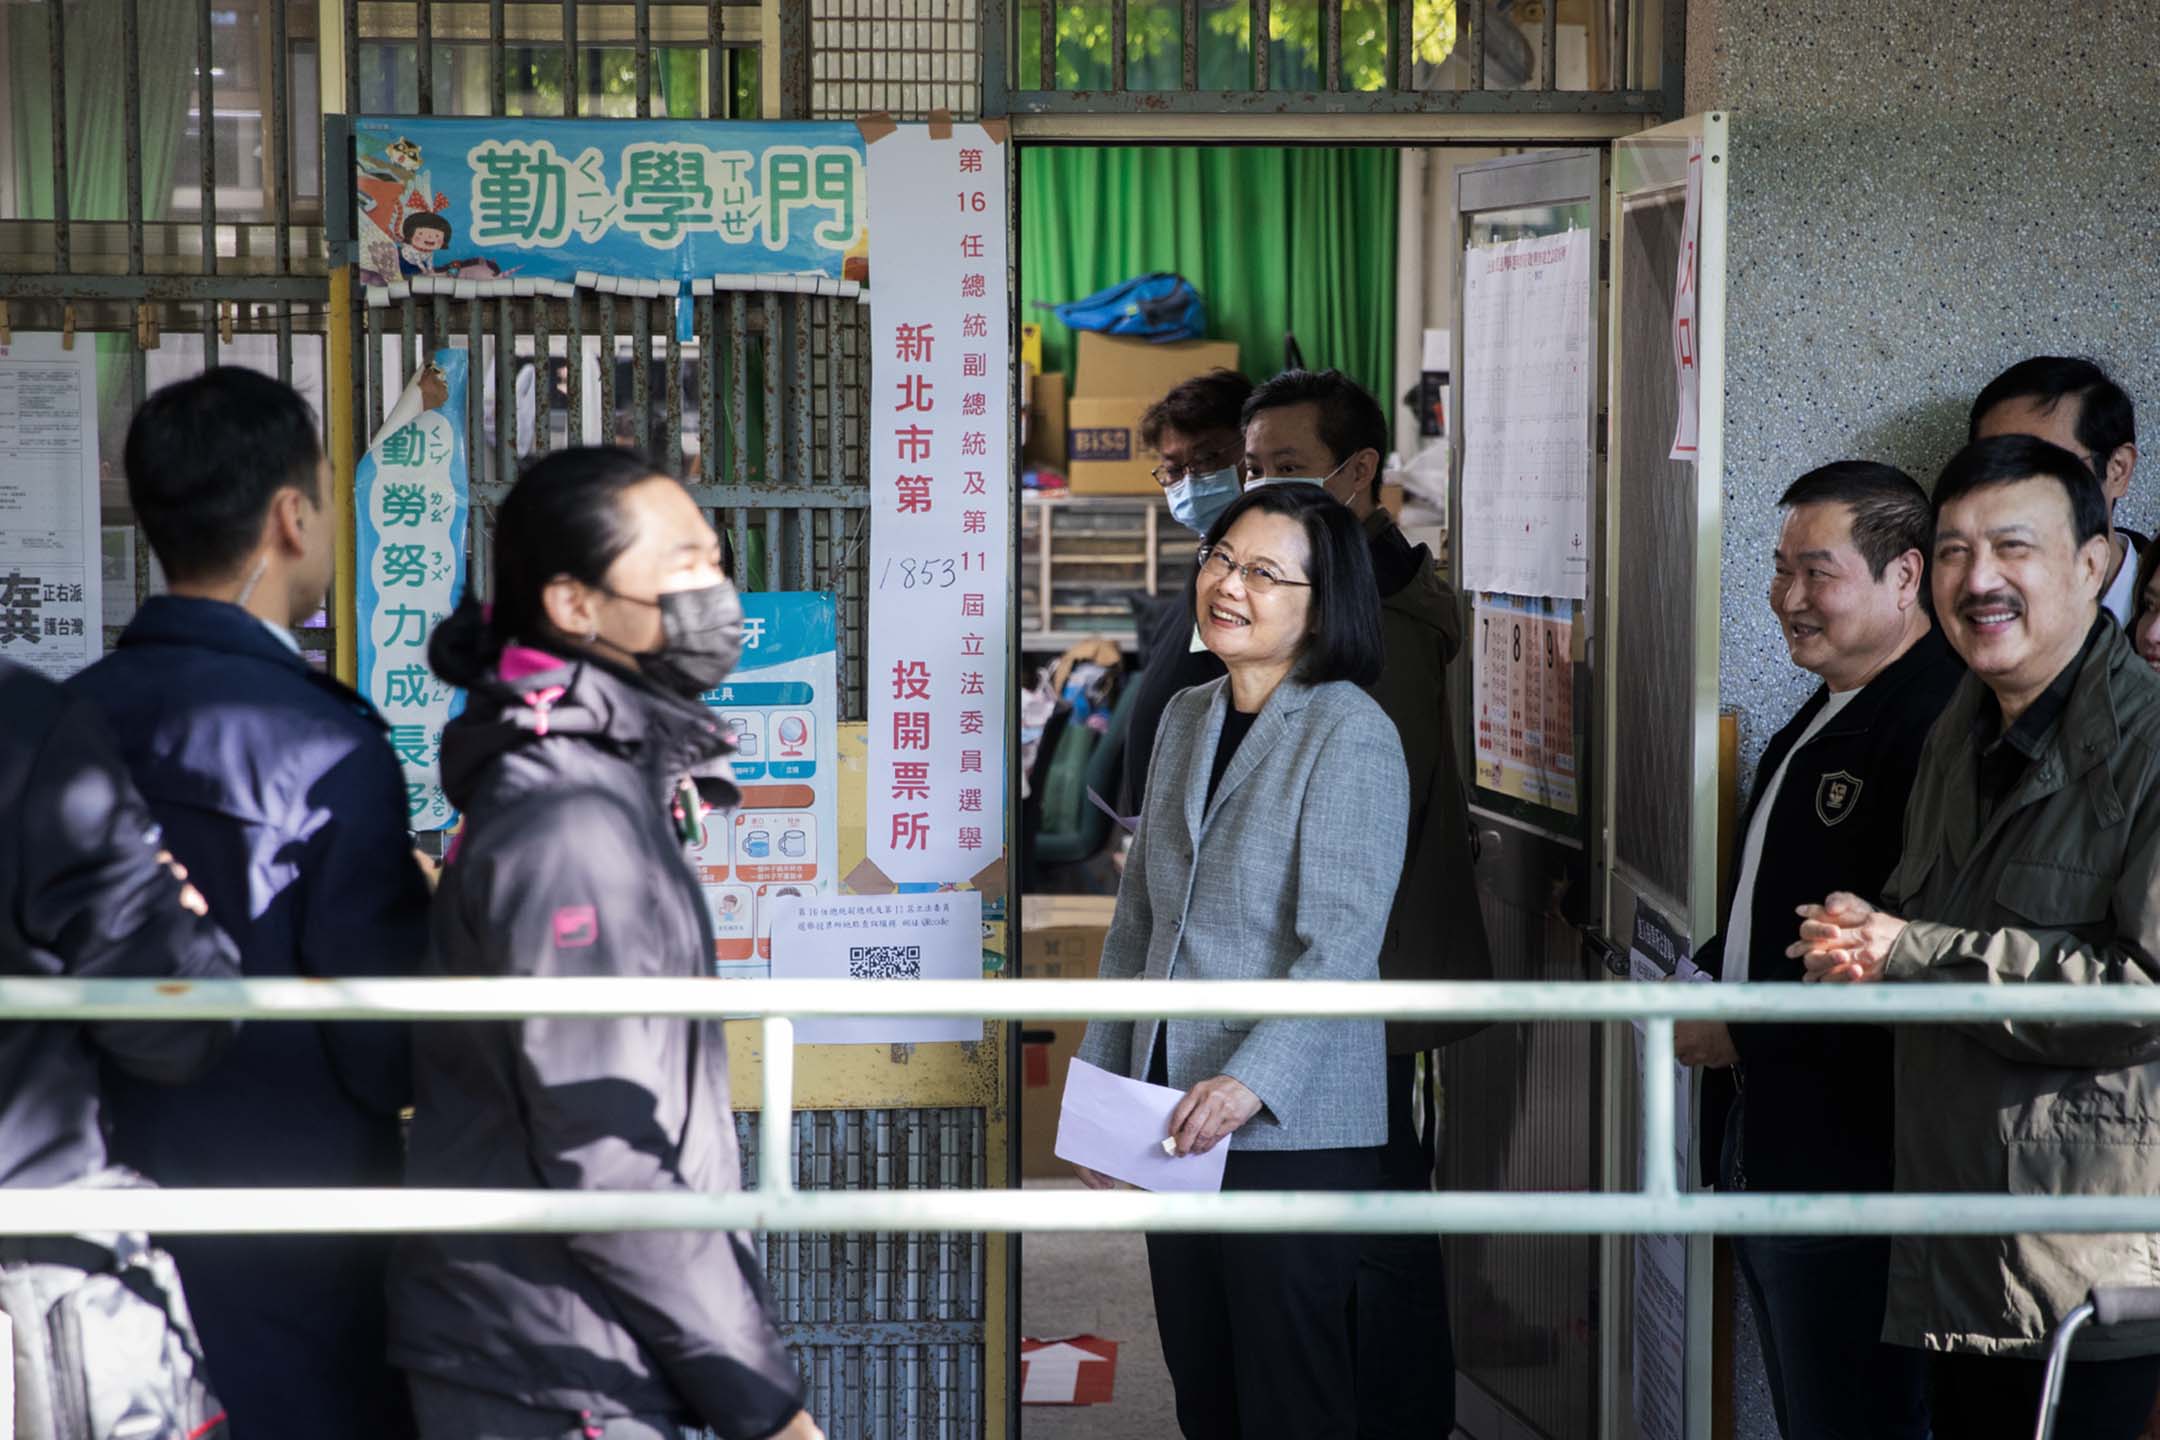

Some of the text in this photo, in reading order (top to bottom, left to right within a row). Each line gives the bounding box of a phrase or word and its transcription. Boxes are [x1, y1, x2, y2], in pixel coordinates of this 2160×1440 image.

[43, 583, 82, 602] 正右派
[879, 322, 957, 851] 新北市第 1853 投開票所
[44, 617, 83, 636] 護台灣
